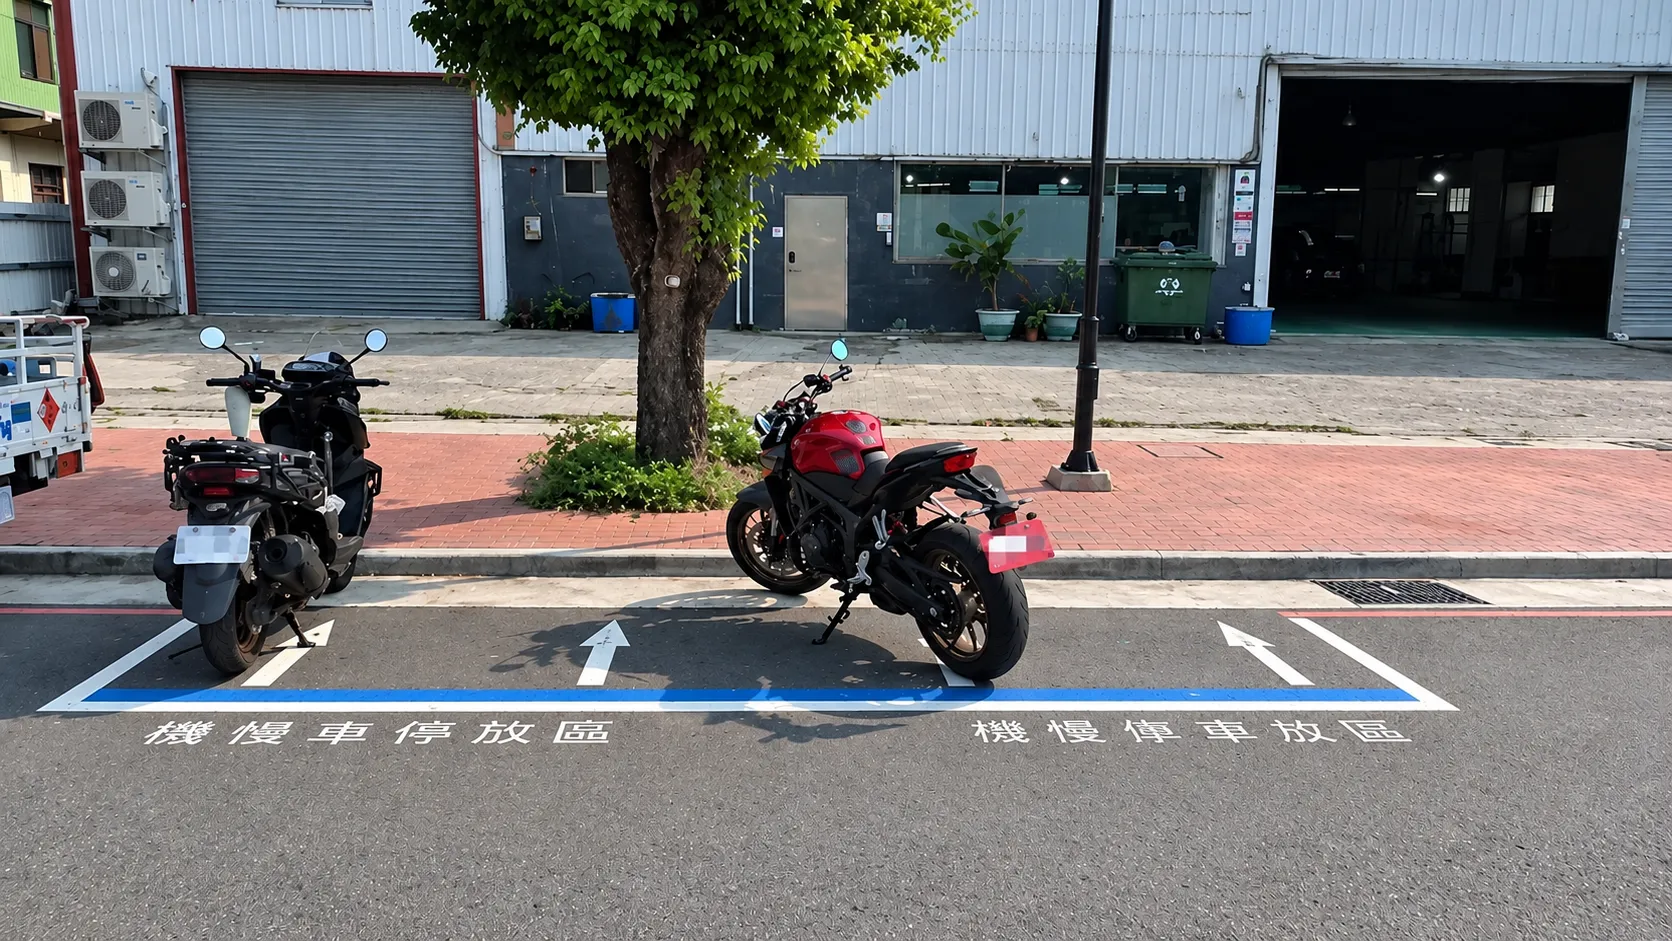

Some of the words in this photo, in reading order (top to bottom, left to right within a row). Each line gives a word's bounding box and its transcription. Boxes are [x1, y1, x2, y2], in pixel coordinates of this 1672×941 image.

[143, 719, 614, 746] 機慢車停放區
